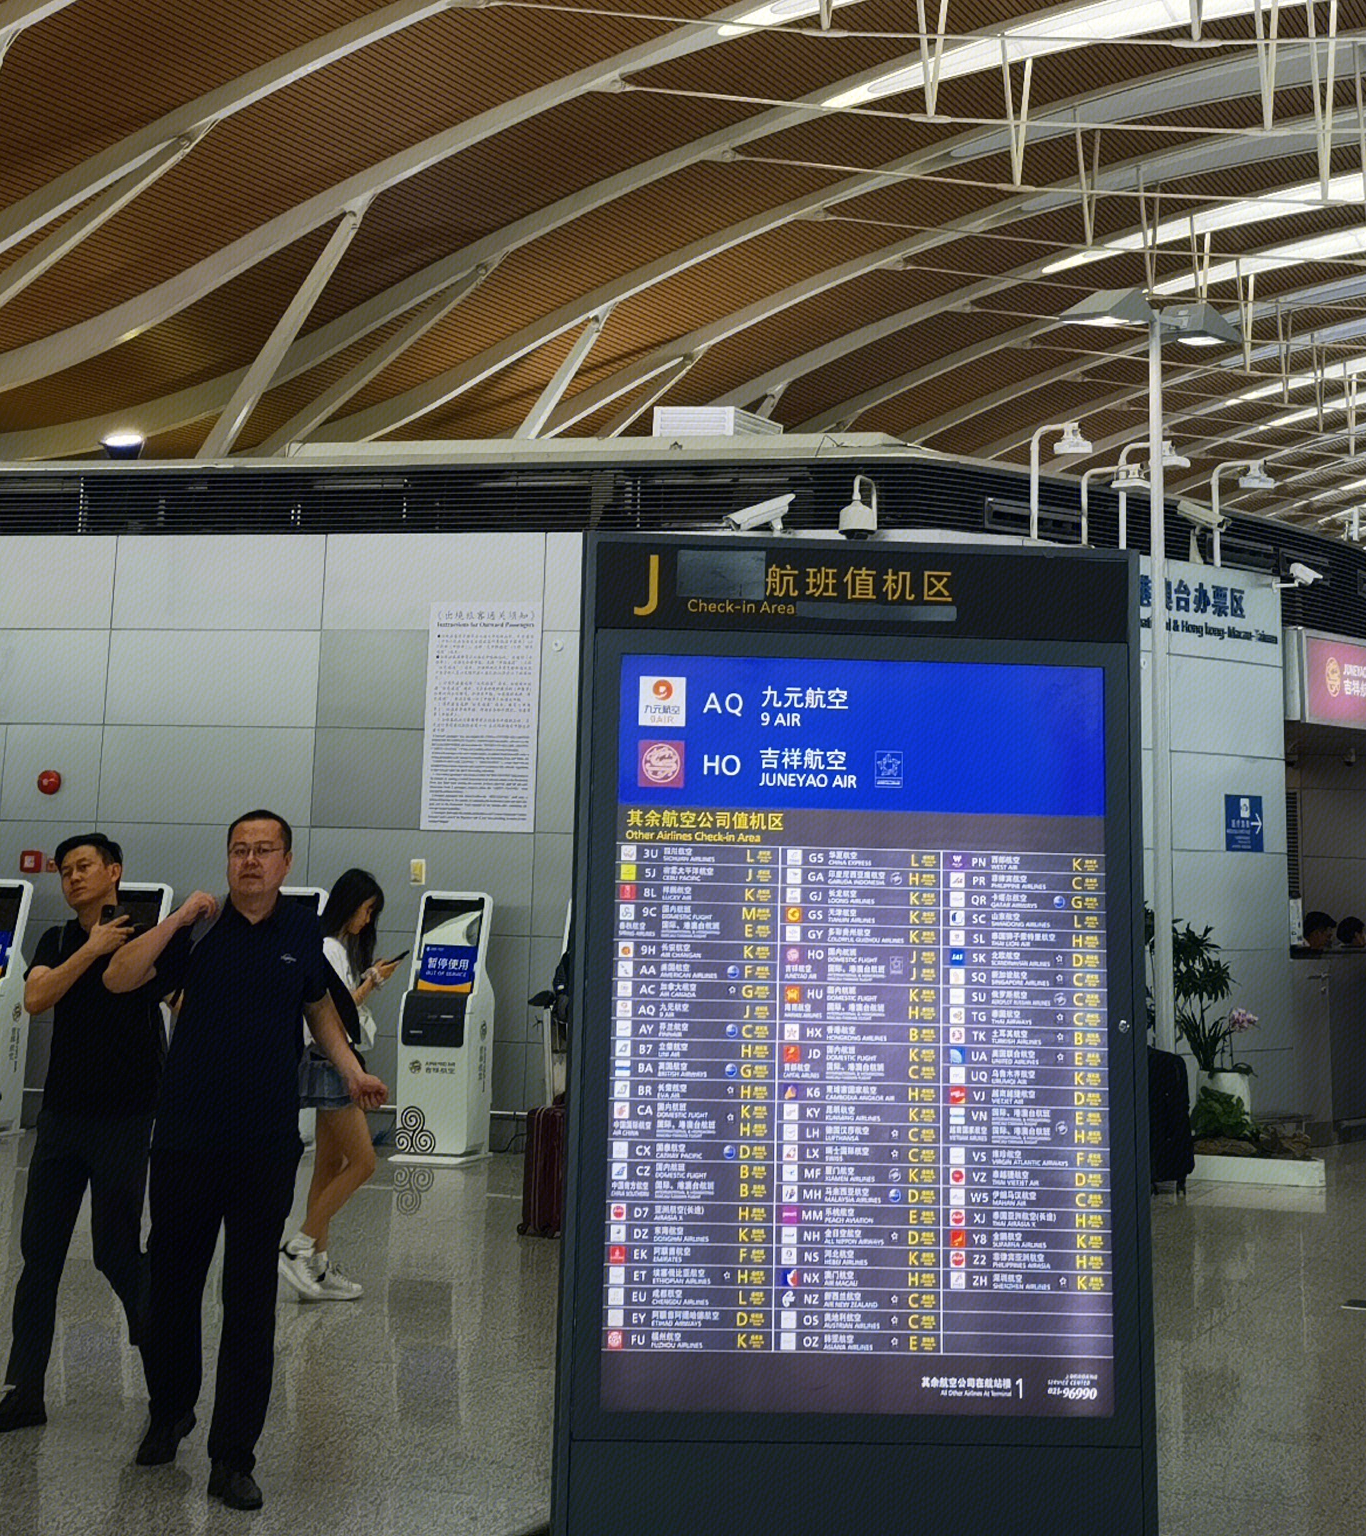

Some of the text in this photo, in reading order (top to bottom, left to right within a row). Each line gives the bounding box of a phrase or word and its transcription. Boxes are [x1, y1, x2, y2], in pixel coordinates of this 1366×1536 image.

[633, 554, 659, 616] J
[765, 564, 953, 602] 航班值机区
[687, 599, 795, 615] Check-in Area
[761, 686, 849, 710] 九元航空
[702, 692, 744, 717] AQ
[760, 712, 801, 727] 9 AIR
[759, 747, 847, 771] 吉祥航空
[703, 754, 741, 776] HO
[758, 772, 857, 789] JUNEYAO AIR
[626, 809, 784, 831] 其余航空公司值机区
[625, 830, 761, 843] Other Airlines Check-in Area
[644, 849, 755, 863] 3U L
[911, 854, 919, 867] L
[972, 858, 1082, 870] PN K
[646, 868, 753, 882] 5J J
[808, 872, 824, 881] GA
[973, 876, 985, 885] PR
[644, 888, 755, 901] 8L K
[810, 892, 821, 901] GJ
[972, 895, 986, 906] QR
[643, 907, 656, 916] 9C
[808, 910, 822, 920] GS
[973, 914, 985, 923] SC
[808, 930, 823, 939] GY
[973, 934, 985, 943] SL
[641, 945, 655, 955] 9H
[808, 950, 823, 959] HO
[973, 954, 986, 962] SK
[427, 957, 470, 971] 暂停使用
[640, 965, 656, 974] AA
[972, 972, 986, 983] SQ
[640, 985, 655, 994] AC
[807, 989, 822, 999] HU
[972, 992, 986, 1002] SU
[638, 1005, 655, 1016] AQ
[972, 1012, 986, 1021] TG
[639, 1024, 653, 1034] AY
[807, 1028, 821, 1037] HX
[972, 1031, 985, 1041] TK
[639, 1045, 652, 1054] B7
[808, 1049, 820, 1058] JD
[972, 1052, 987, 1061] UA
[638, 1063, 653, 1073] BA
[972, 1071, 987, 1082] UQ
[638, 1086, 651, 1095] BR
[807, 1088, 820, 1097] K6
[973, 1091, 985, 1101] VJ
[637, 1105, 652, 1115] CA
[807, 1108, 820, 1117] KY
[972, 1111, 987, 1121] VN
[807, 1128, 819, 1138] LH
[636, 1145, 650, 1155] CX
[807, 1148, 819, 1158] LX
[973, 1152, 986, 1161] VS
[805, 1168, 820, 1178] MF
[804, 1189, 821, 1199] MH
[971, 1193, 988, 1202] W5
[634, 1207, 648, 1217] D7
[802, 1210, 822, 1220] MM
[974, 1213, 985, 1223] XJ
[804, 1231, 819, 1241] NH
[973, 1234, 986, 1244] Y8
[634, 1249, 647, 1259] EK
[805, 1252, 819, 1262] NS
[973, 1255, 986, 1265] Z2
[634, 1271, 646, 1281] ET
[804, 1273, 819, 1283] NX
[973, 1276, 987, 1286] ZH
[632, 1292, 646, 1302] EU
[804, 1294, 818, 1304] NZ
[633, 1313, 646, 1323] EY
[804, 1315, 819, 1325] OS
[632, 1335, 645, 1345] FU
[804, 1337, 818, 1347] OZ
[1015, 1378, 1023, 1400] 1
